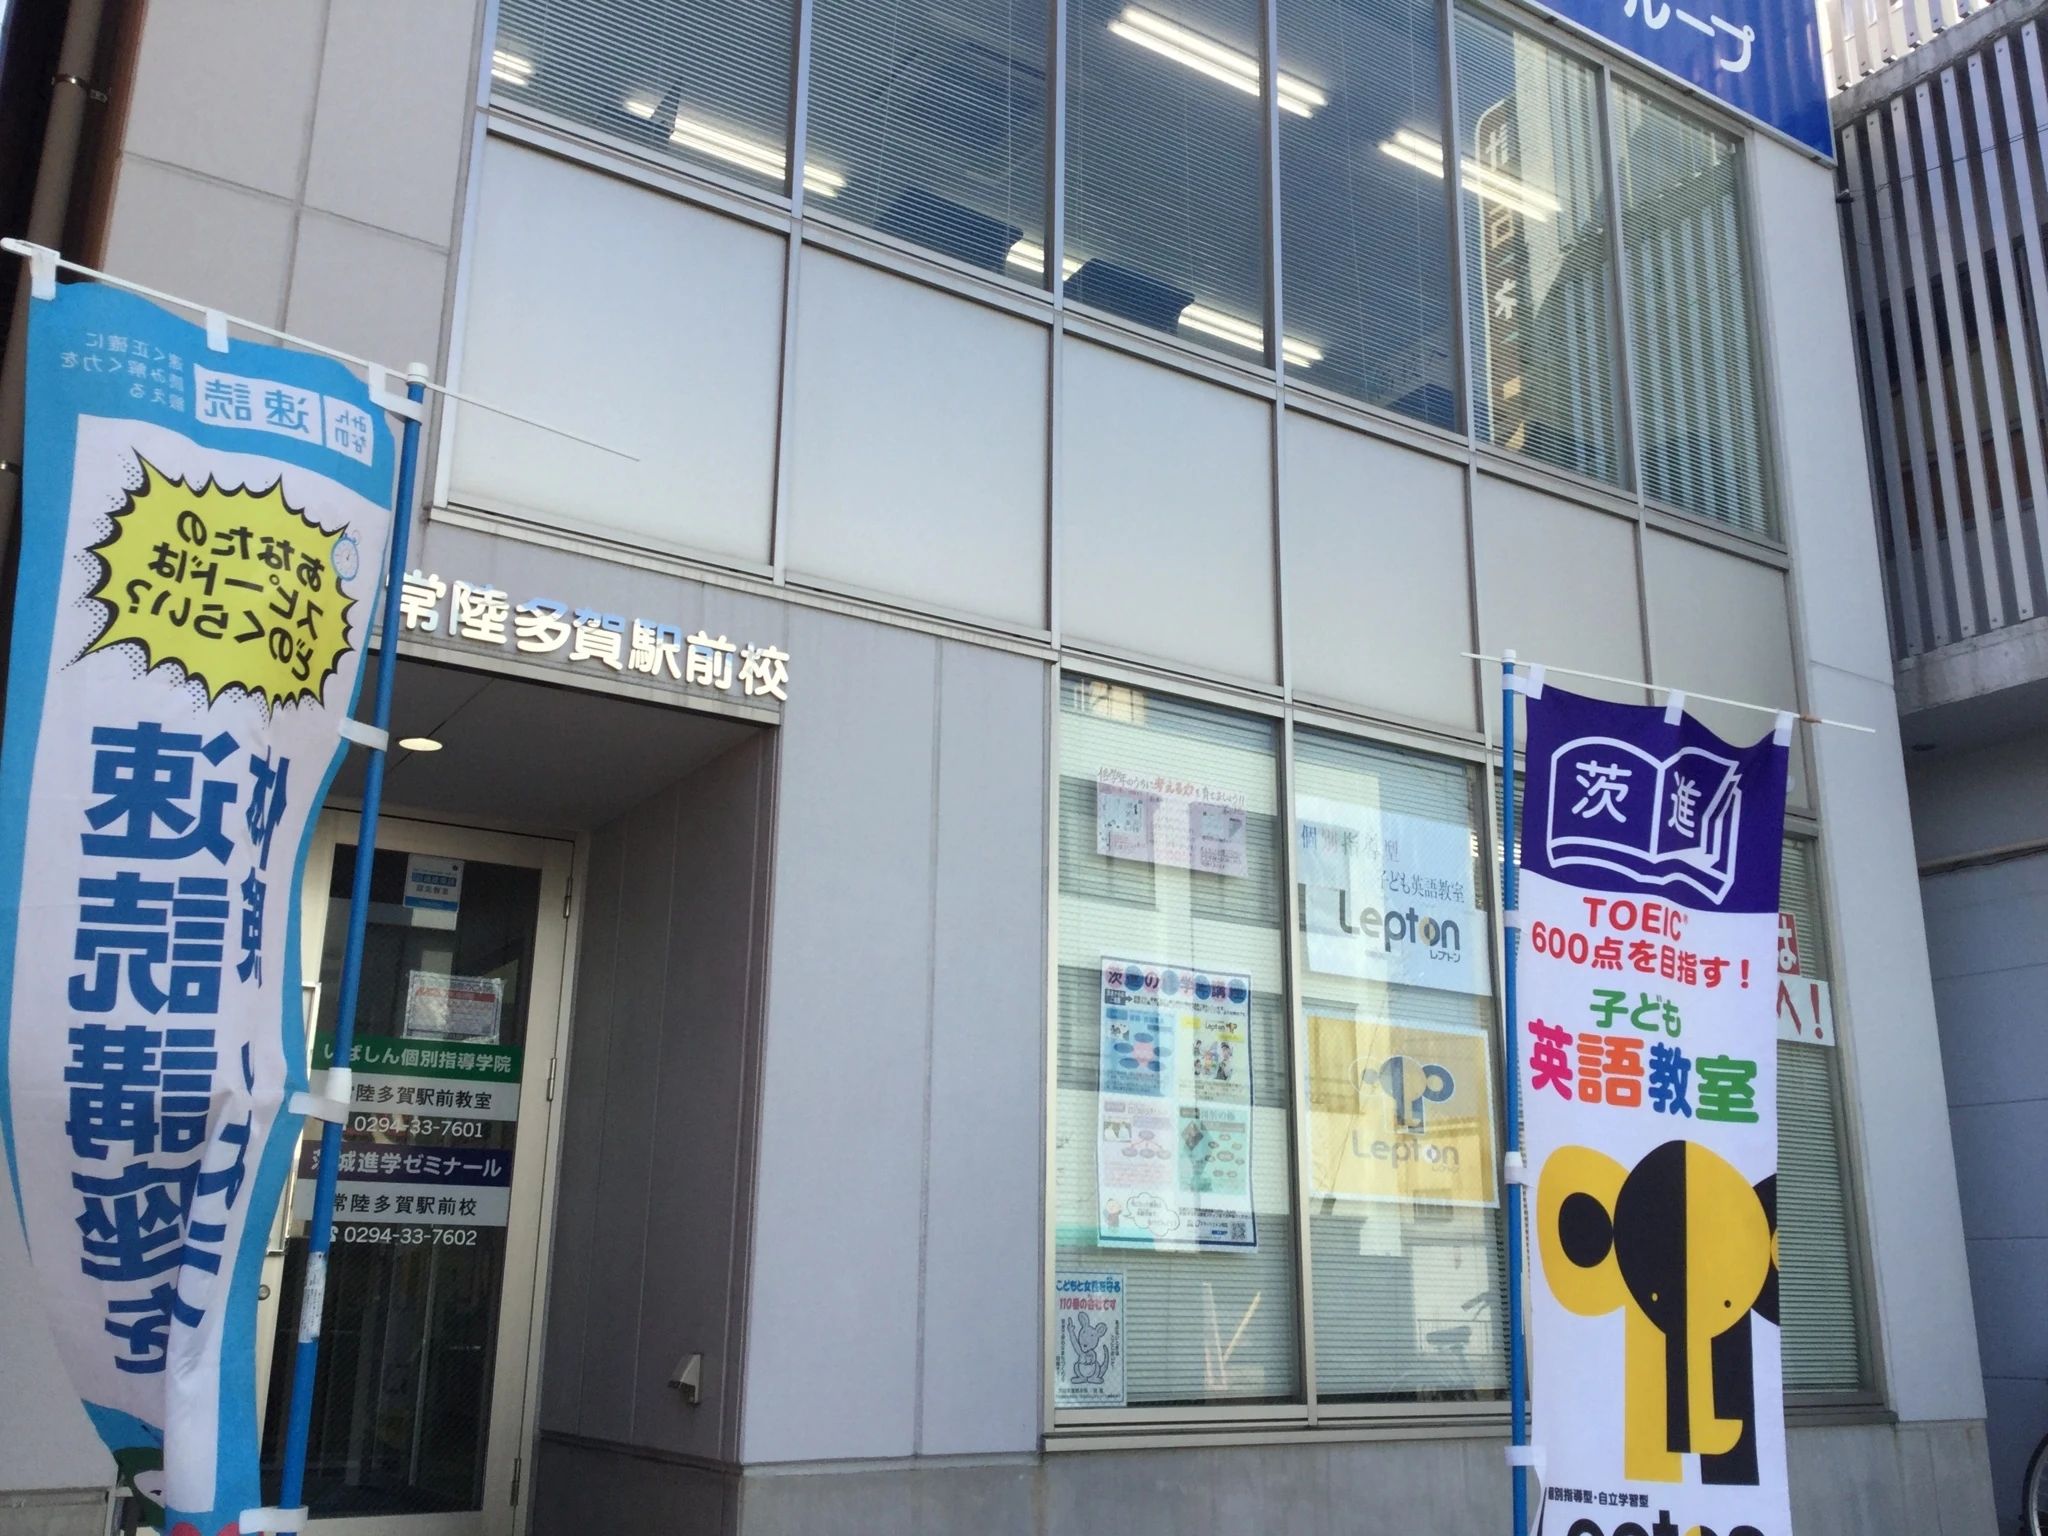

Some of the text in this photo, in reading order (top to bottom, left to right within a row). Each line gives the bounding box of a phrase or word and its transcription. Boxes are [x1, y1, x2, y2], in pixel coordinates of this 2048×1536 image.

[386, 570, 790, 701] 常陸多賀駅前校
[1339, 889, 1460, 952] Lepton
[1589, 988, 1683, 1038] 子ども
[1527, 1018, 1760, 1124] 英語教室
[351, 1083, 492, 1110] 陸多賀駅前教室
[354, 1116, 483, 1138] 0294-33-7601
[1352, 1129, 1460, 1169] Lepton
[333, 1192, 478, 1217] 常陸多賀駅前校
[343, 1226, 478, 1247] 0294-33-7602
